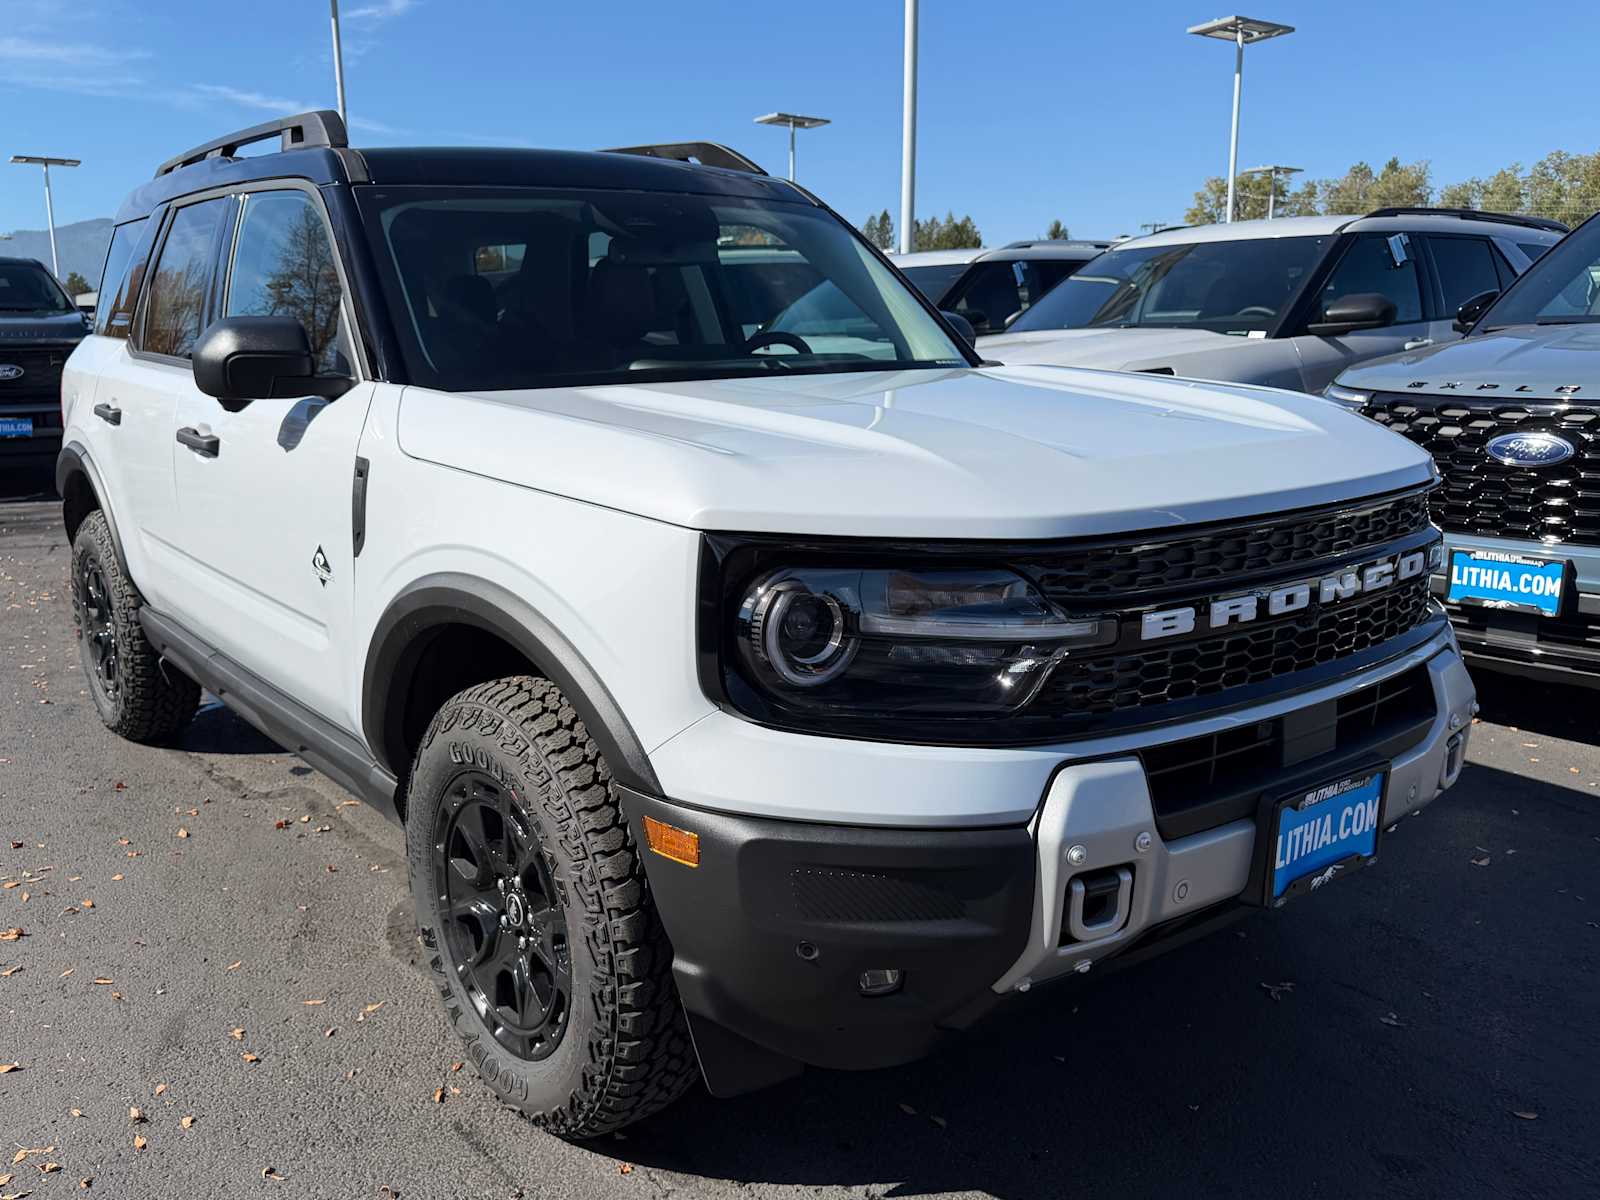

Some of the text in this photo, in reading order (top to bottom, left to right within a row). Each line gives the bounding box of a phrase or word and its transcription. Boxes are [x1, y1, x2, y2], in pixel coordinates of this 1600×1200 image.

[1141, 551, 1425, 641] BRONCO
[1451, 565, 1562, 598] LITHIA.COM
[1275, 796, 1380, 870] LITHIA.COM
